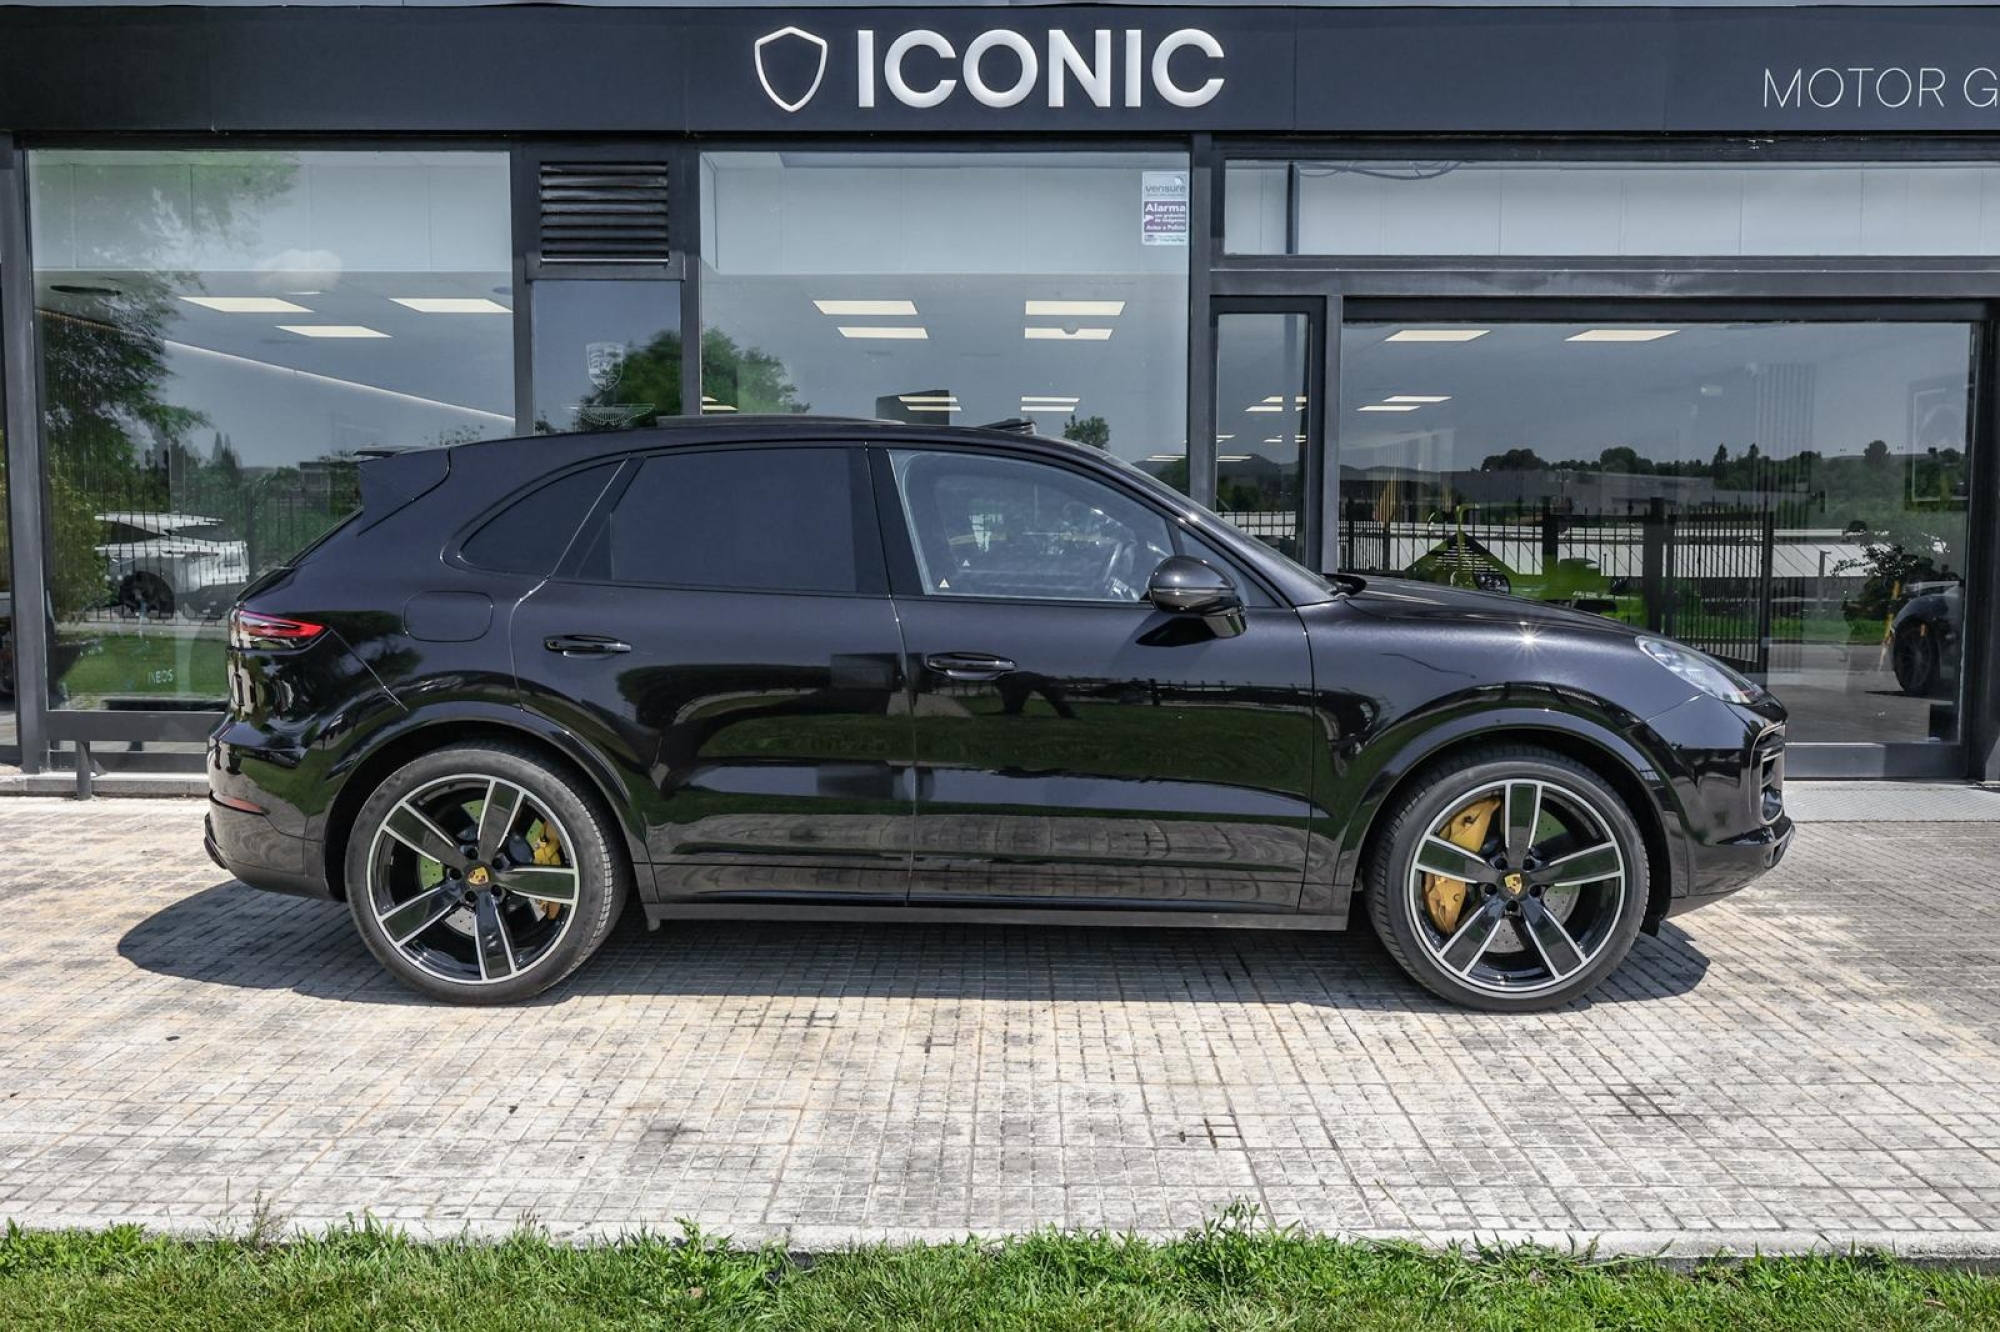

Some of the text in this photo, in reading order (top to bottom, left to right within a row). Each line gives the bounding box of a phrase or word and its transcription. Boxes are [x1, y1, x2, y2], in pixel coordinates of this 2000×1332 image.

[857, 28, 1225, 109] ICONIC
[1763, 67, 1946, 108] MOTOR
[1145, 203, 1186, 212] Alarma
